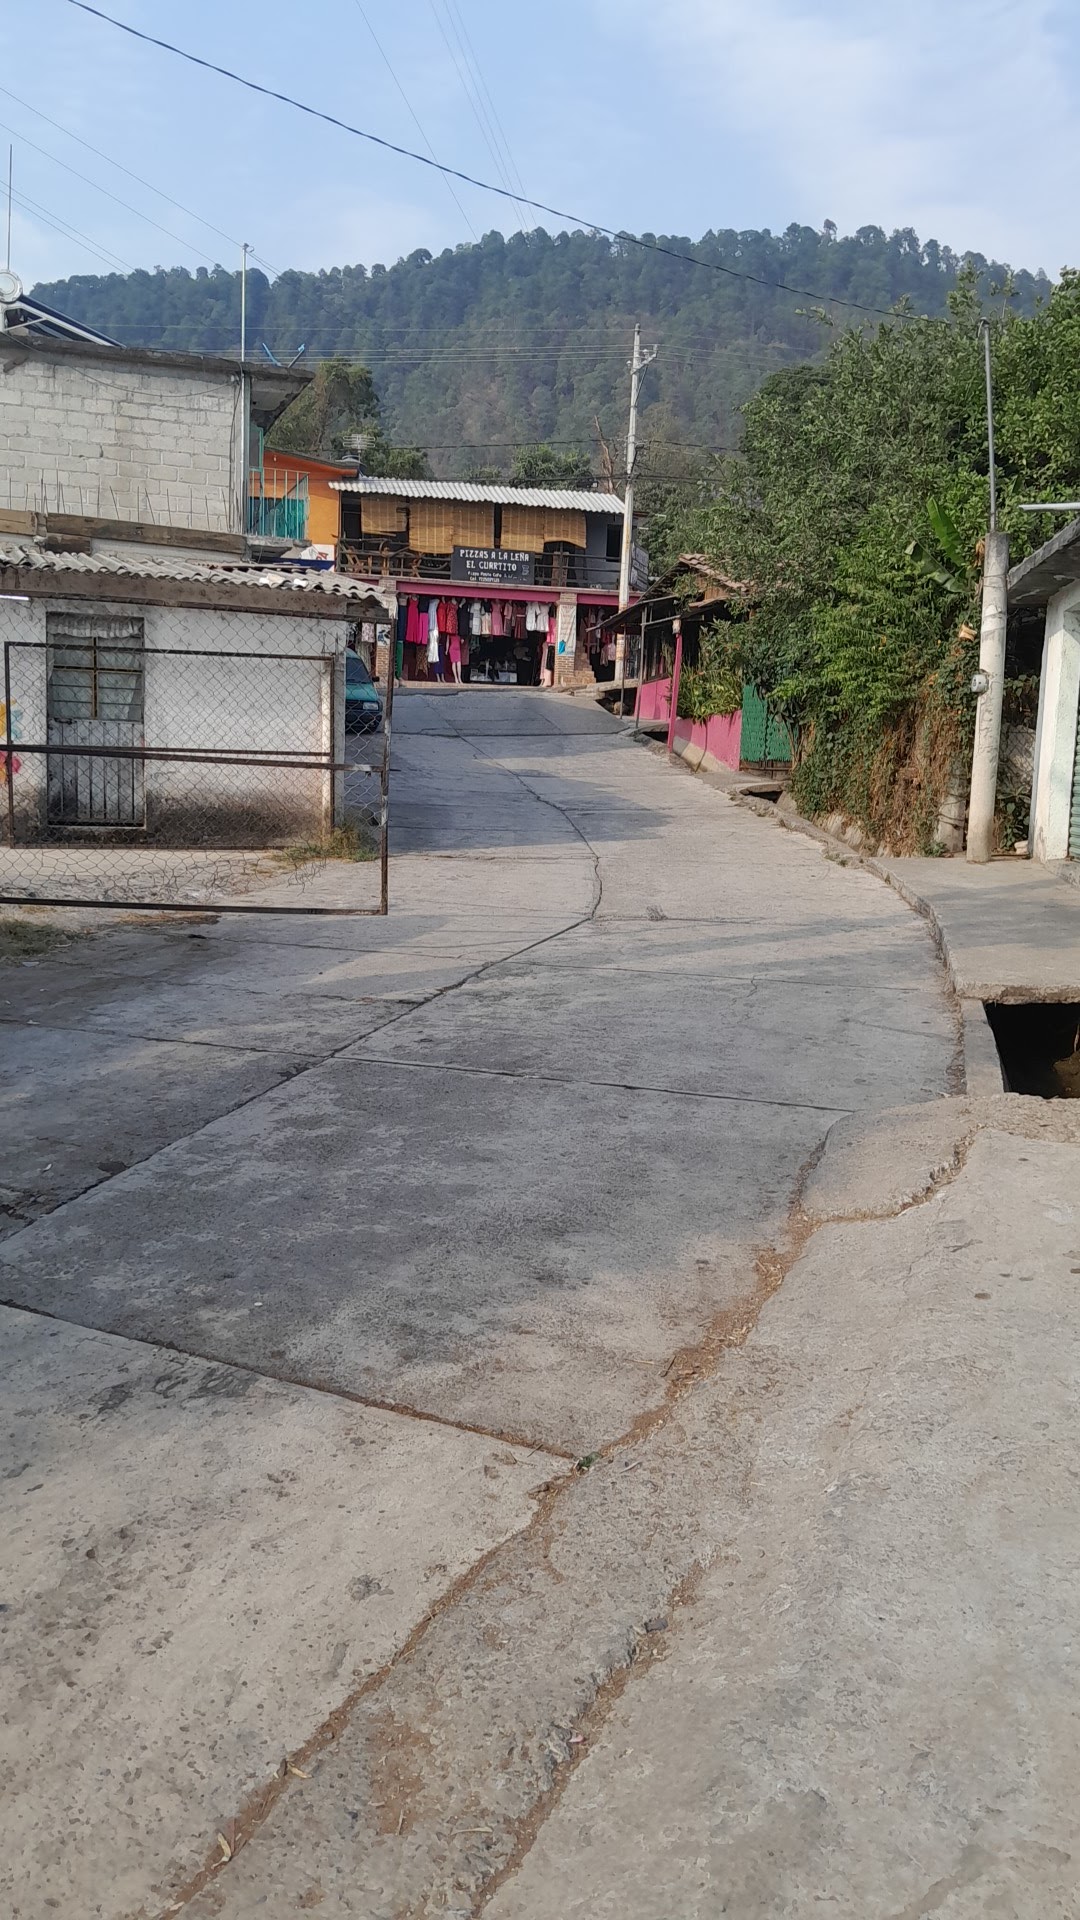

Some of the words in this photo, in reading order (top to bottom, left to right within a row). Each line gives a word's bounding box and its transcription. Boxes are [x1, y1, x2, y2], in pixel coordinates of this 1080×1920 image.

[460, 549, 488, 559] PIZZAS
[491, 551, 496, 559] A
[498, 552, 508, 560] LA
[510, 552, 529, 562] LEÑA
[466, 560, 476, 568] EL
[478, 561, 517, 571] CUARTITO
